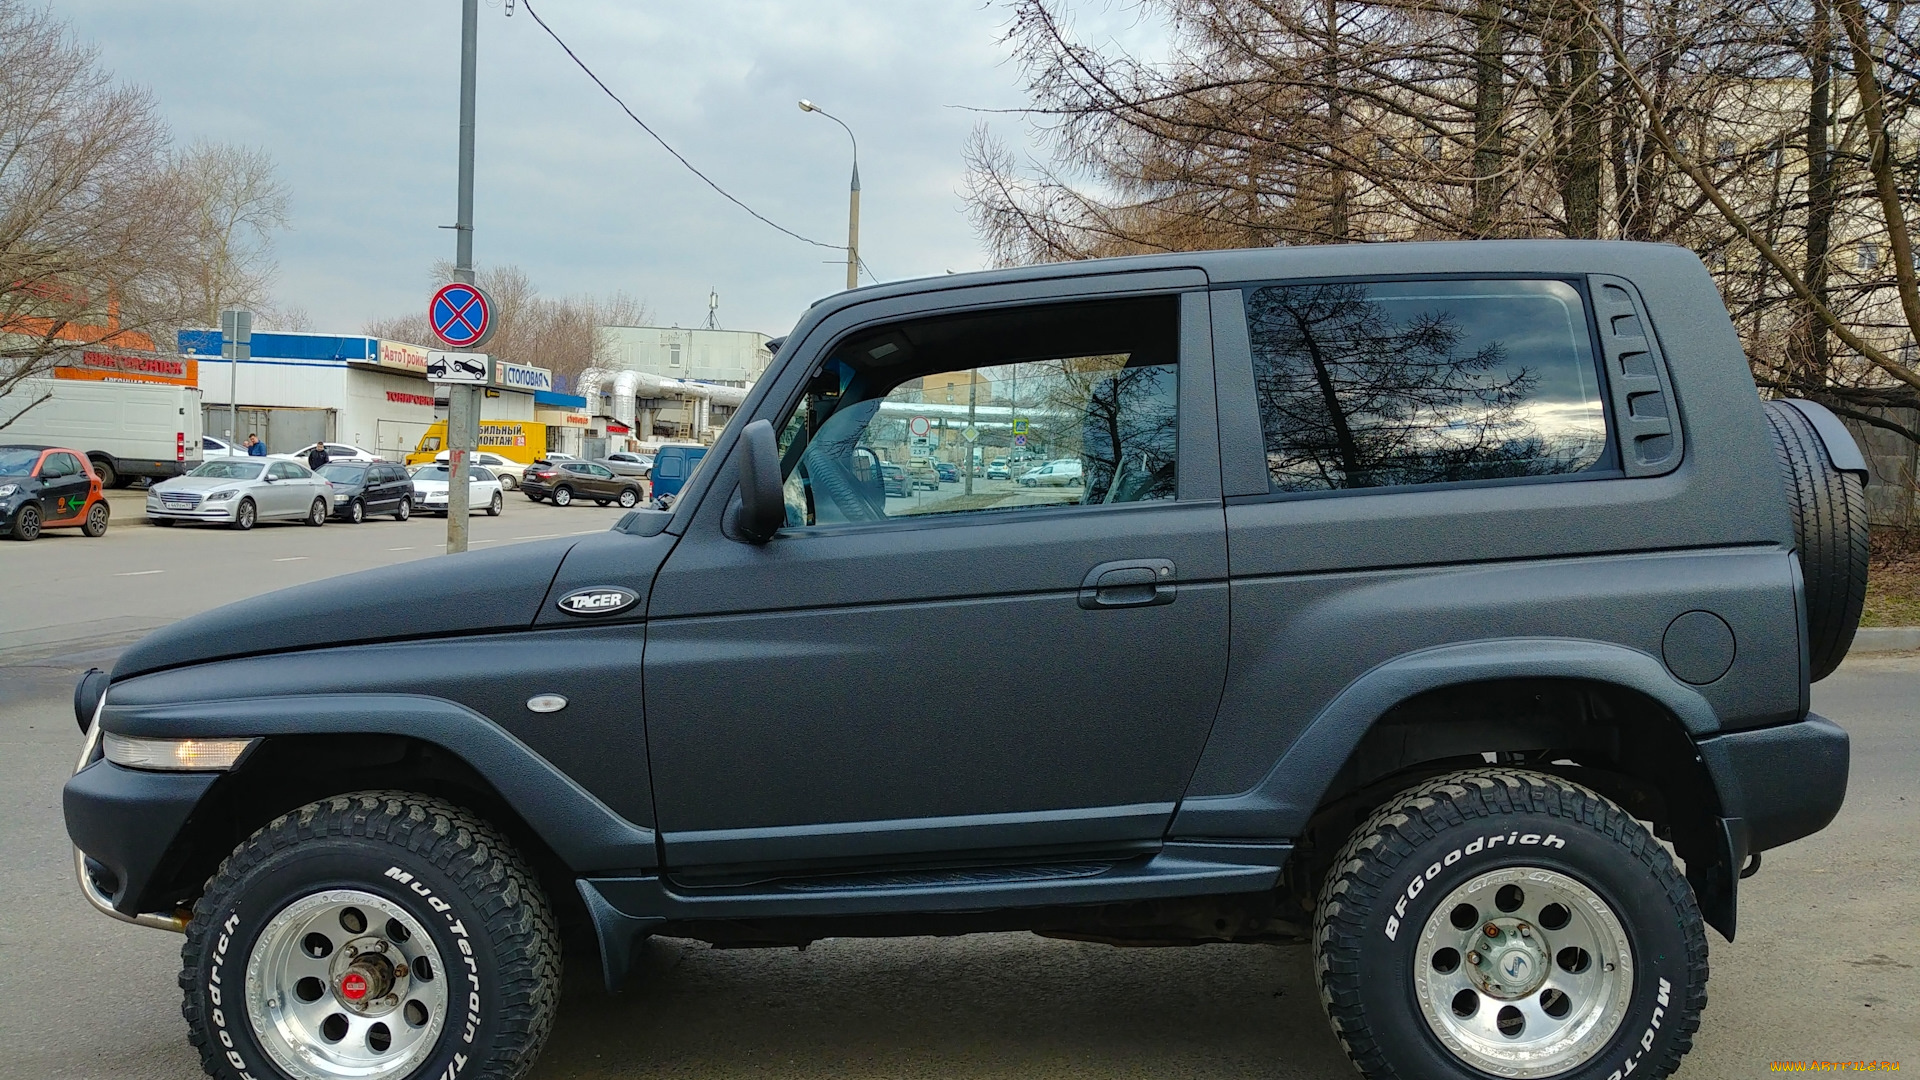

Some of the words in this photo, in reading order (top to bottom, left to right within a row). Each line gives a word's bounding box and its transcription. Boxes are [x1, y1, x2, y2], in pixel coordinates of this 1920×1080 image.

[508, 367, 543, 387] СТОЛОВАЯ
[386, 391, 434, 406] ТОНИРОВКА
[570, 593, 622, 609] TAGER
[1384, 832, 1566, 942] BFGoodrich
[384, 866, 481, 1045] Mud-Terrain
